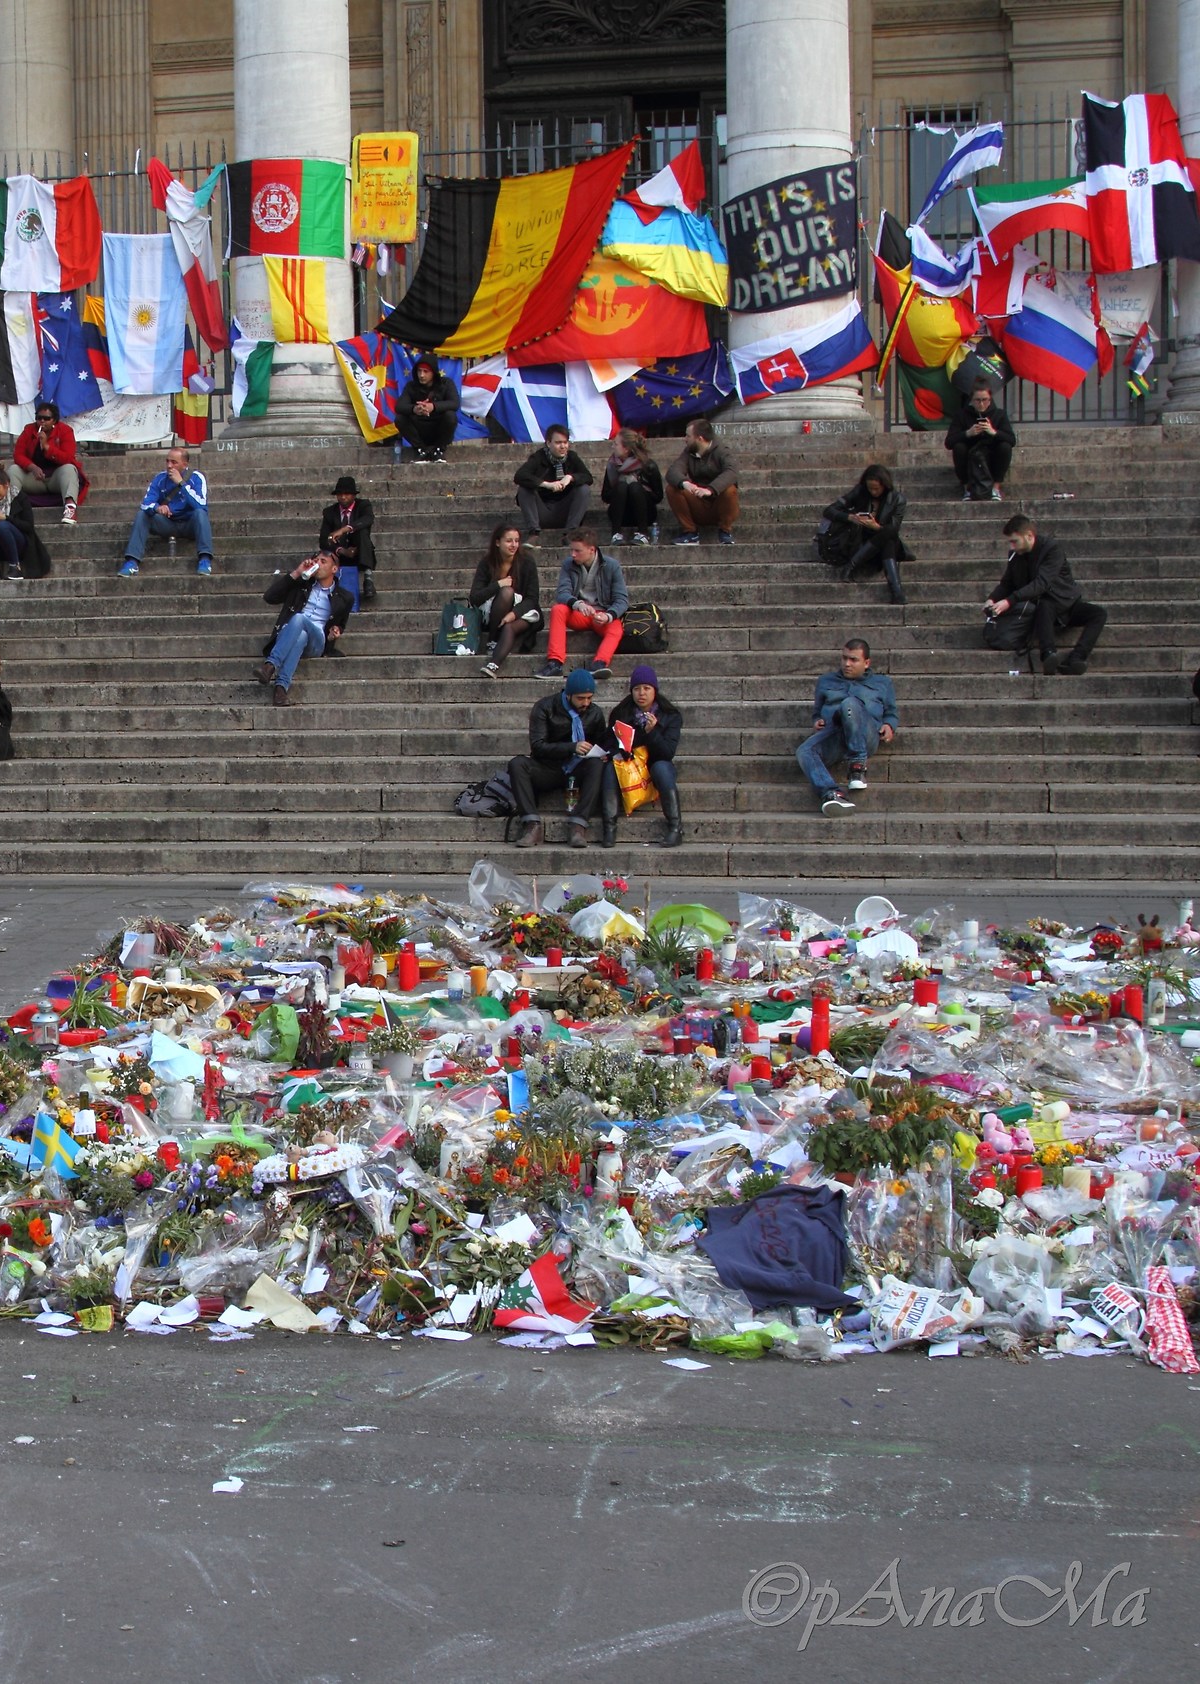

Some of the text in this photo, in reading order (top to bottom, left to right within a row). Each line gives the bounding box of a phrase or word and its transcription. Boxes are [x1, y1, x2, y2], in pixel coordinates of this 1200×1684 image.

[725, 167, 856, 236] THIS IS
[755, 215, 835, 264] OUR
[489, 250, 550, 280] FORCE
[1103, 1284, 1136, 1309] HART
